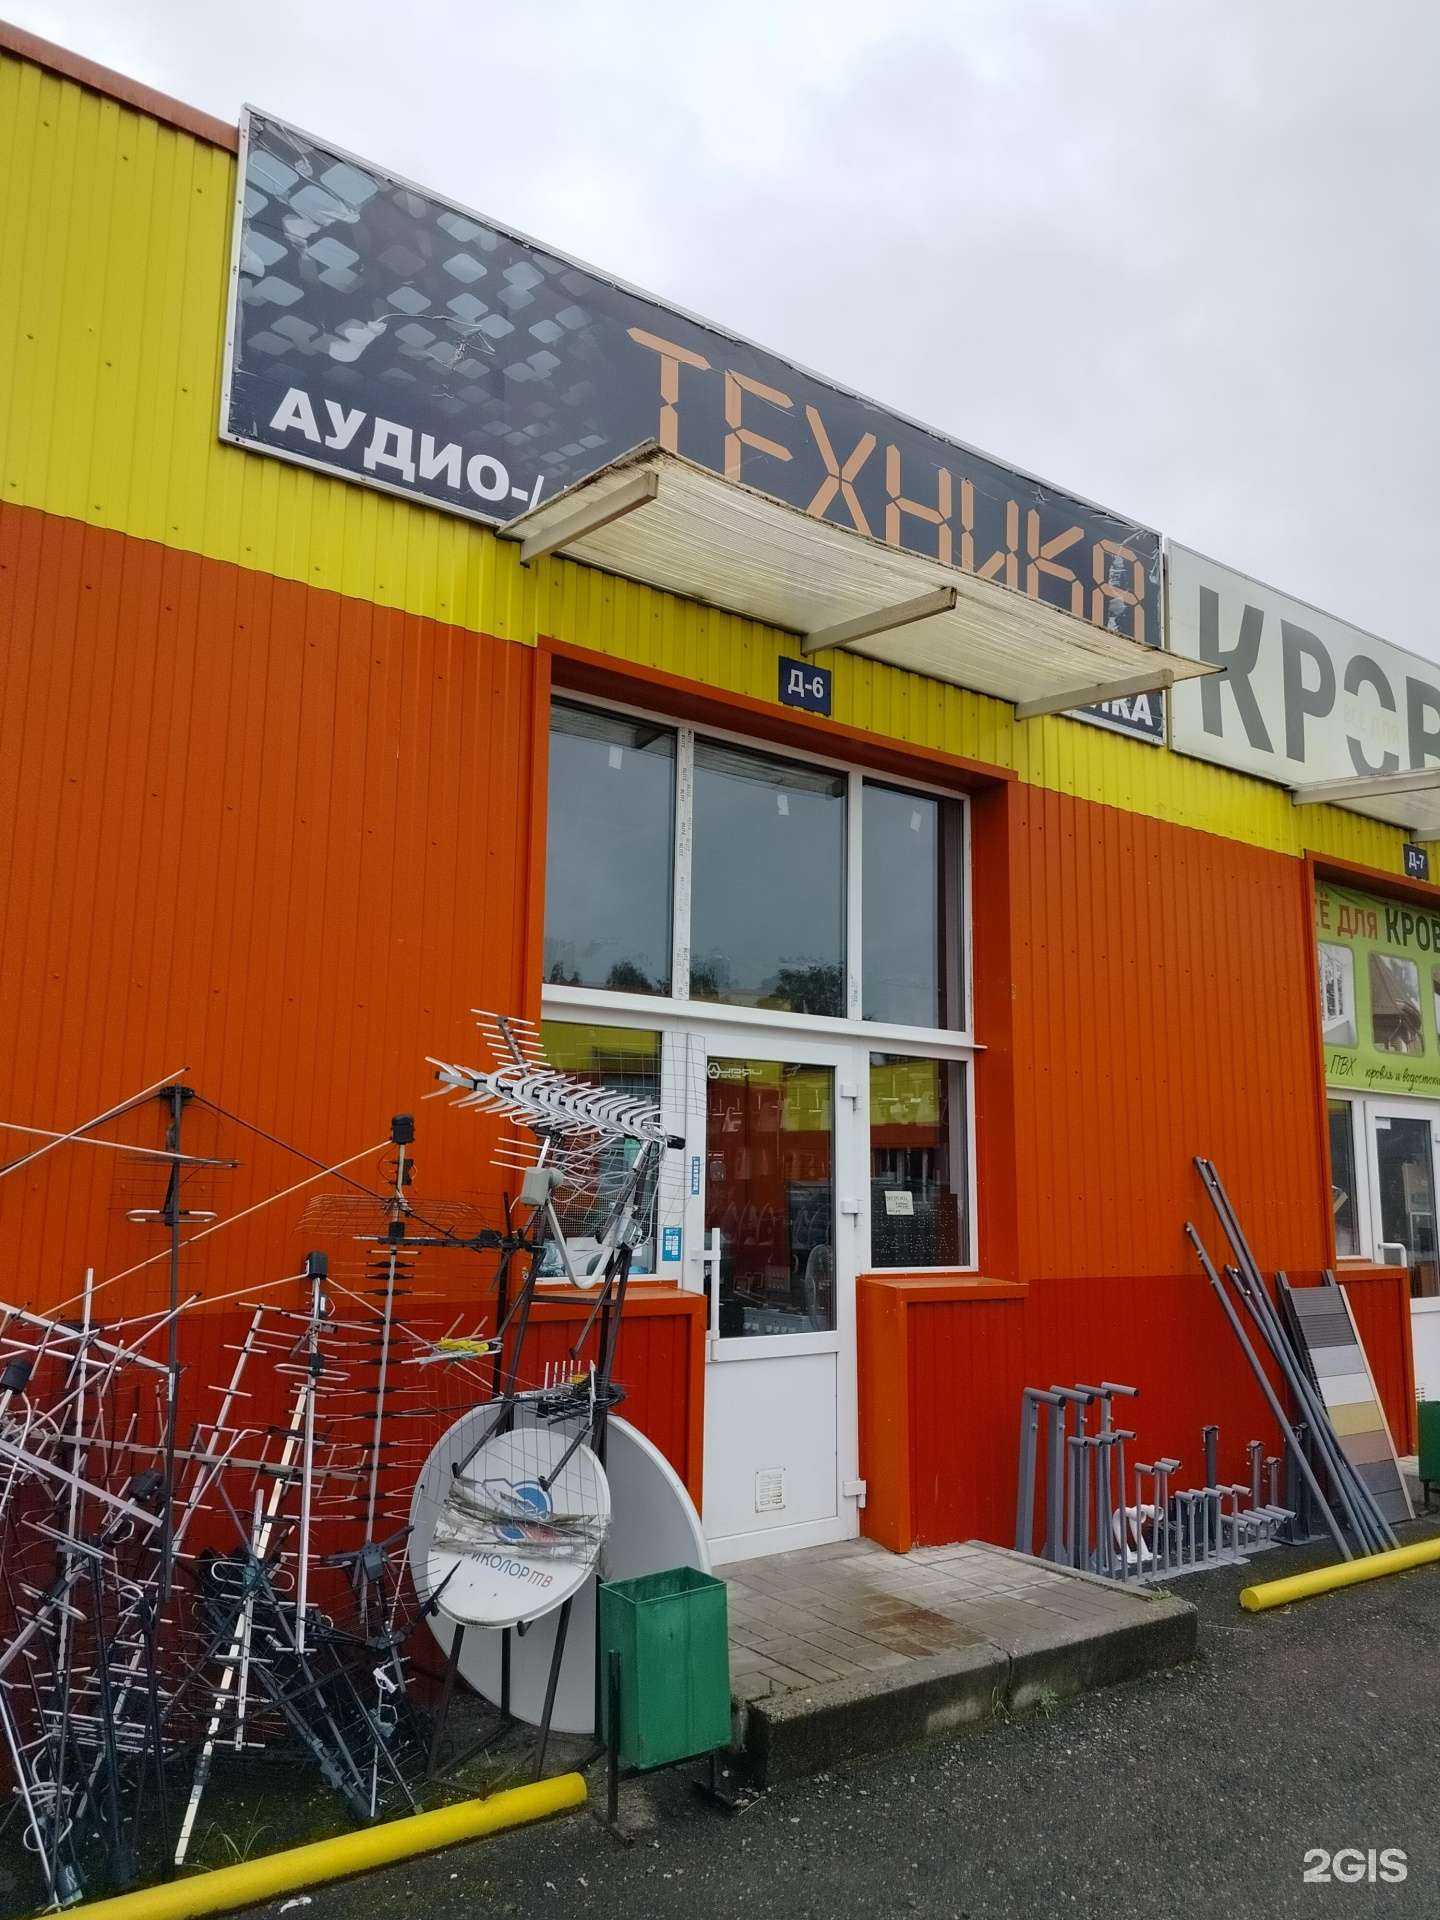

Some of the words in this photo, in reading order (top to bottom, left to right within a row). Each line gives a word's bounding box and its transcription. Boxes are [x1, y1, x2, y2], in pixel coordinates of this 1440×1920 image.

[626, 326, 1145, 644] ТЕХНИКА
[787, 668, 824, 698] Д-6
[1408, 851, 1425, 870] Д-7
[1337, 904, 1378, 940] ДЛЯ
[1329, 1054, 1358, 1077] ПВХ
